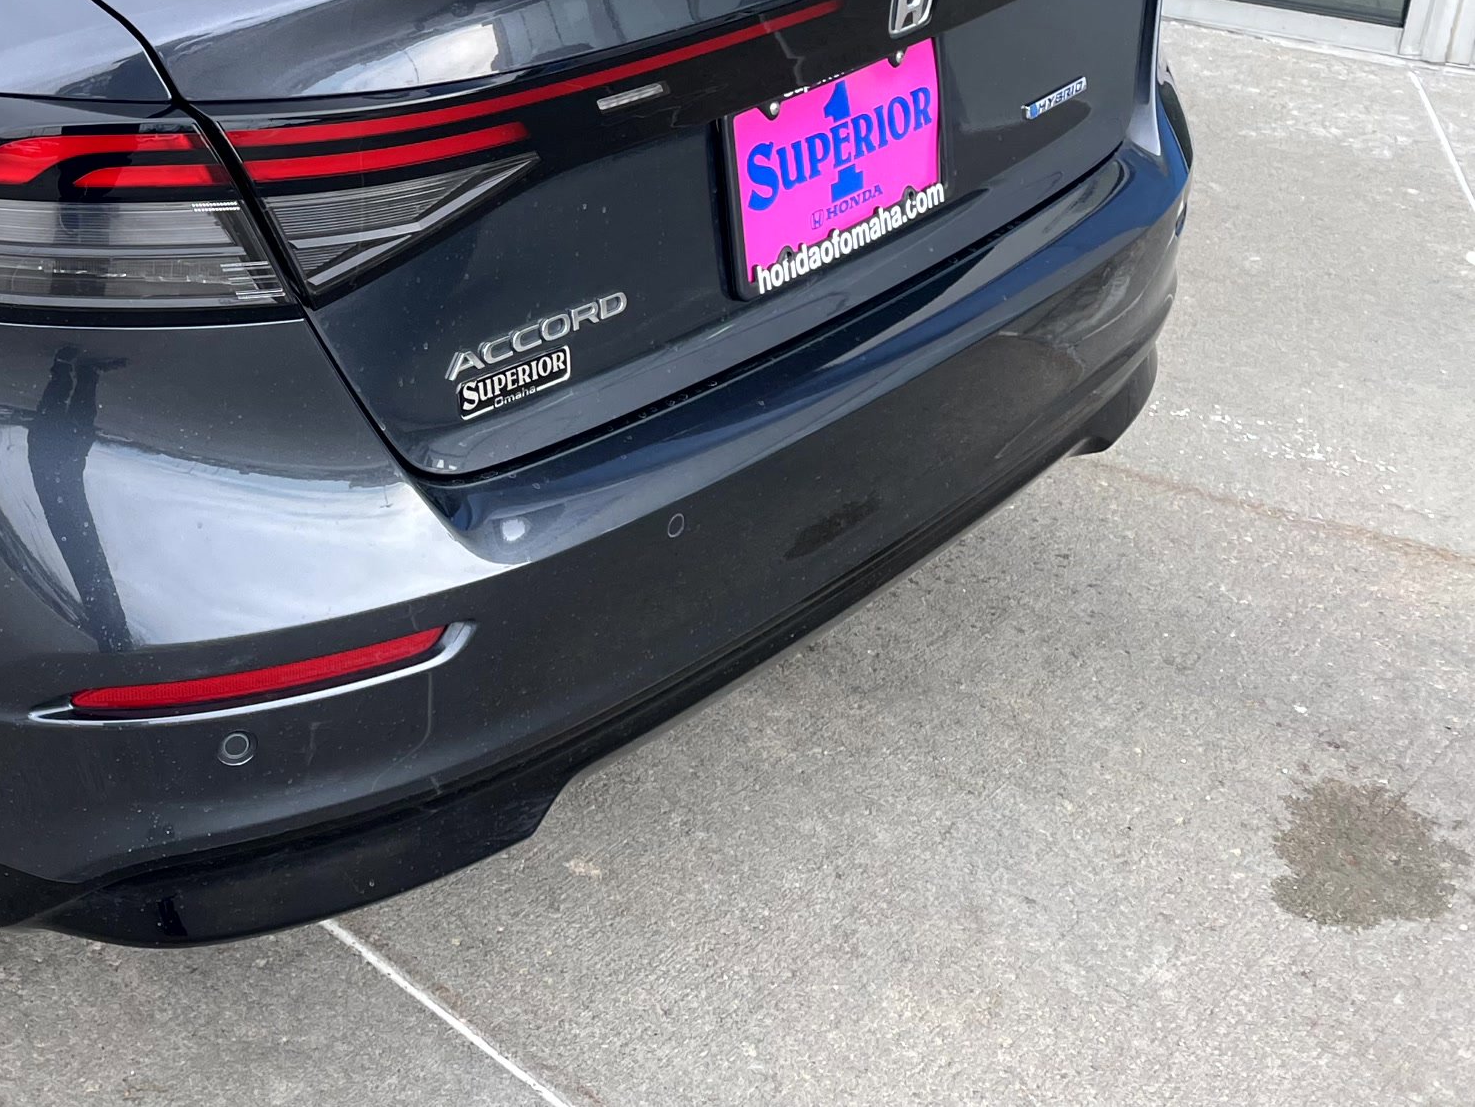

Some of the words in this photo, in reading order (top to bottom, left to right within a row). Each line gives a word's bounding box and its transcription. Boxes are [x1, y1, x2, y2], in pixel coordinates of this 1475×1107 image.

[1037, 80, 1084, 114] HYBRID
[746, 87, 933, 211] SUPERIOR
[826, 184, 884, 221] HONDA
[445, 291, 628, 381] ACCORD
[461, 351, 567, 412] SUPERIOR
[493, 385, 537, 409] Omaha
